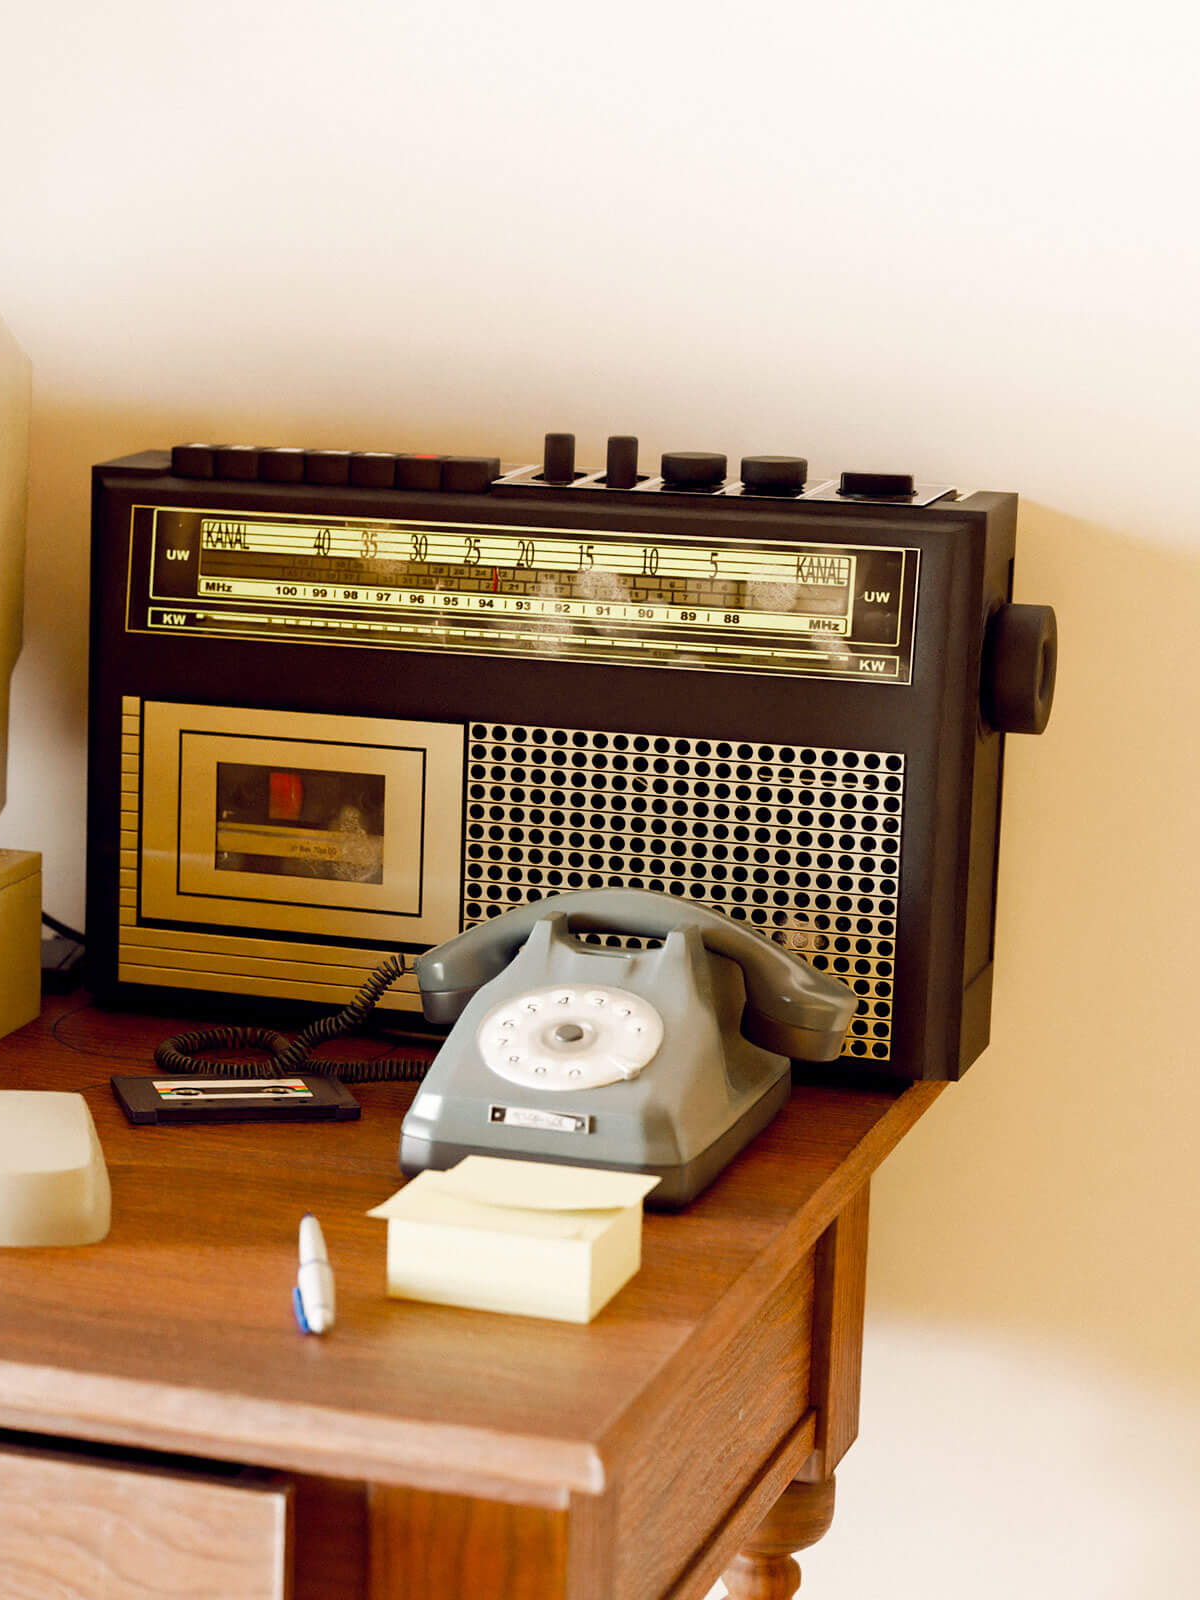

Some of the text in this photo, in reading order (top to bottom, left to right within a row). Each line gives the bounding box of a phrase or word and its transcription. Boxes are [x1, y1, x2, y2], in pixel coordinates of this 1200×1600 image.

[166, 549, 190, 561] UW
[203, 522, 847, 585] KANAL 40 35 30 25 20 15 10 5 KANAL
[864, 591, 891, 604] UW
[205, 582, 840, 632] MHz 100 99 98 97 96 95 94 93 92 91 90 89 88 MHz
[162, 613, 187, 626] KW
[859, 659, 886, 672] KW
